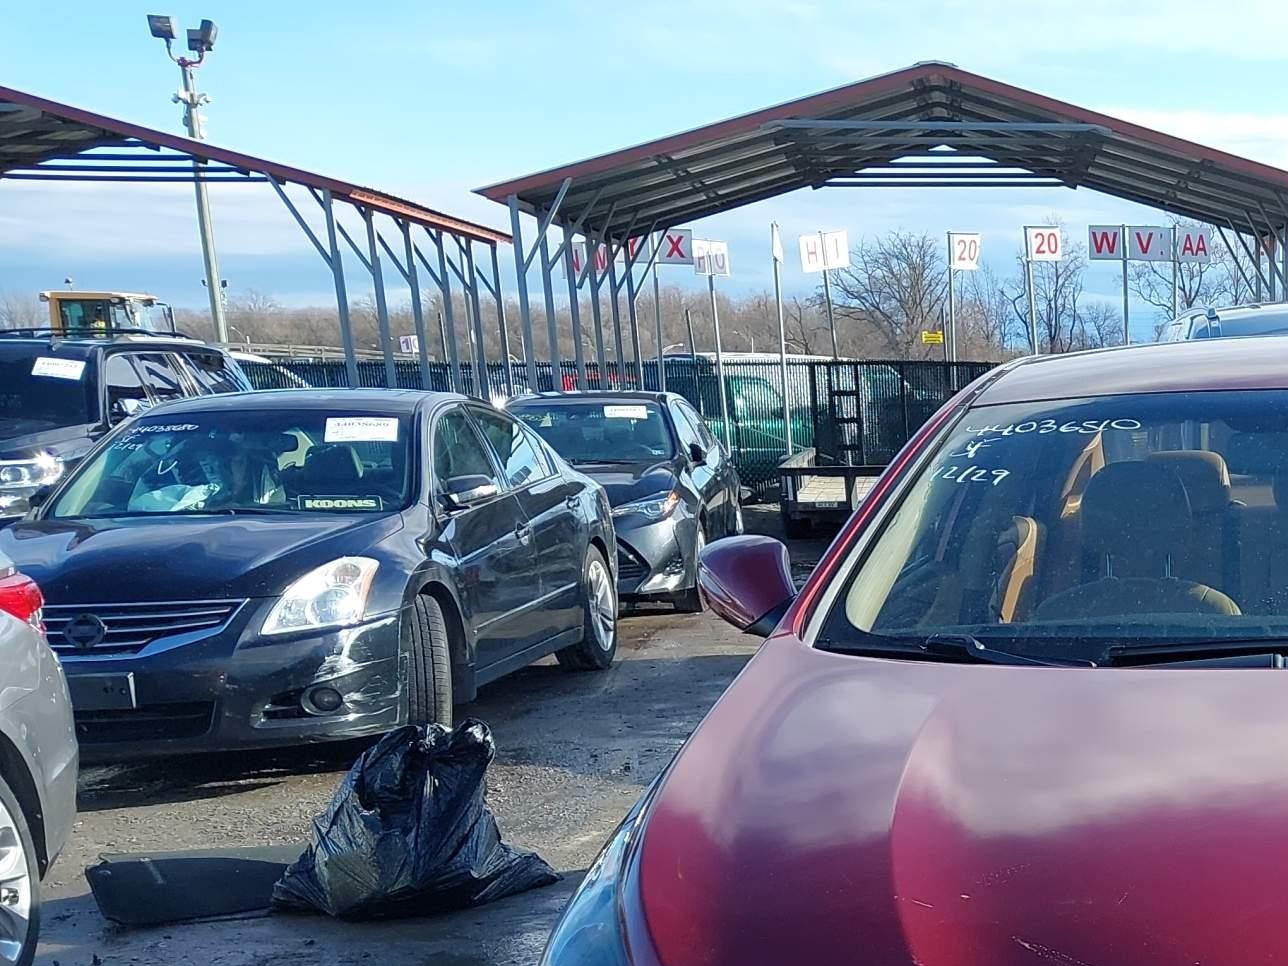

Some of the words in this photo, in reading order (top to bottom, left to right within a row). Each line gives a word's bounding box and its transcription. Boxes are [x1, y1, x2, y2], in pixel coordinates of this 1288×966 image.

[665, 235, 686, 258] X
[806, 240, 818, 265] H
[957, 239, 978, 262] 20
[1034, 232, 1059, 255] 20
[1091, 231, 1118, 254] W
[1181, 233, 1208, 257] AA
[930, 465, 1011, 486] 12/29
[304, 499, 377, 508] KOONS
